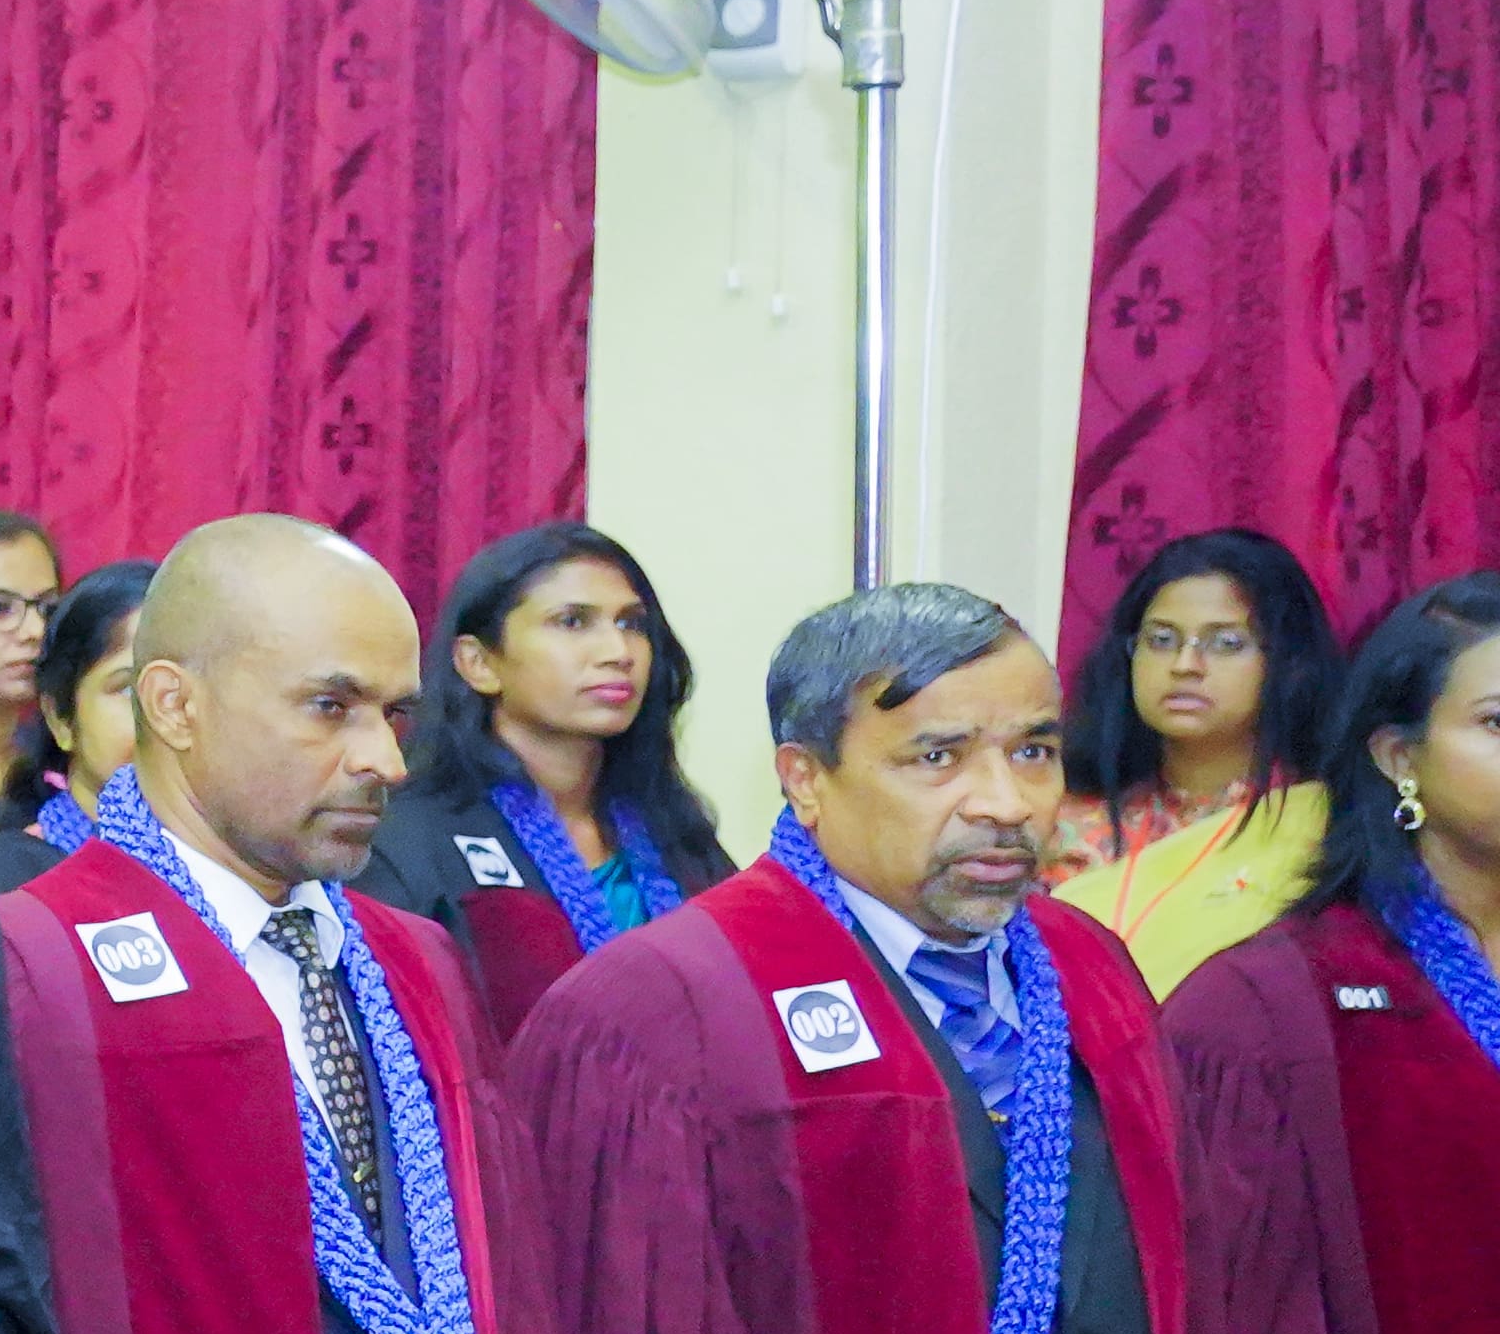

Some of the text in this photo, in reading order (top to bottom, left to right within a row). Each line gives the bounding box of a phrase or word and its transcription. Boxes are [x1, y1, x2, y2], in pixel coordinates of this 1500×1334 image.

[96, 936, 161, 972] 003
[1338, 986, 1384, 1009] 001
[790, 1002, 853, 1041] 002
